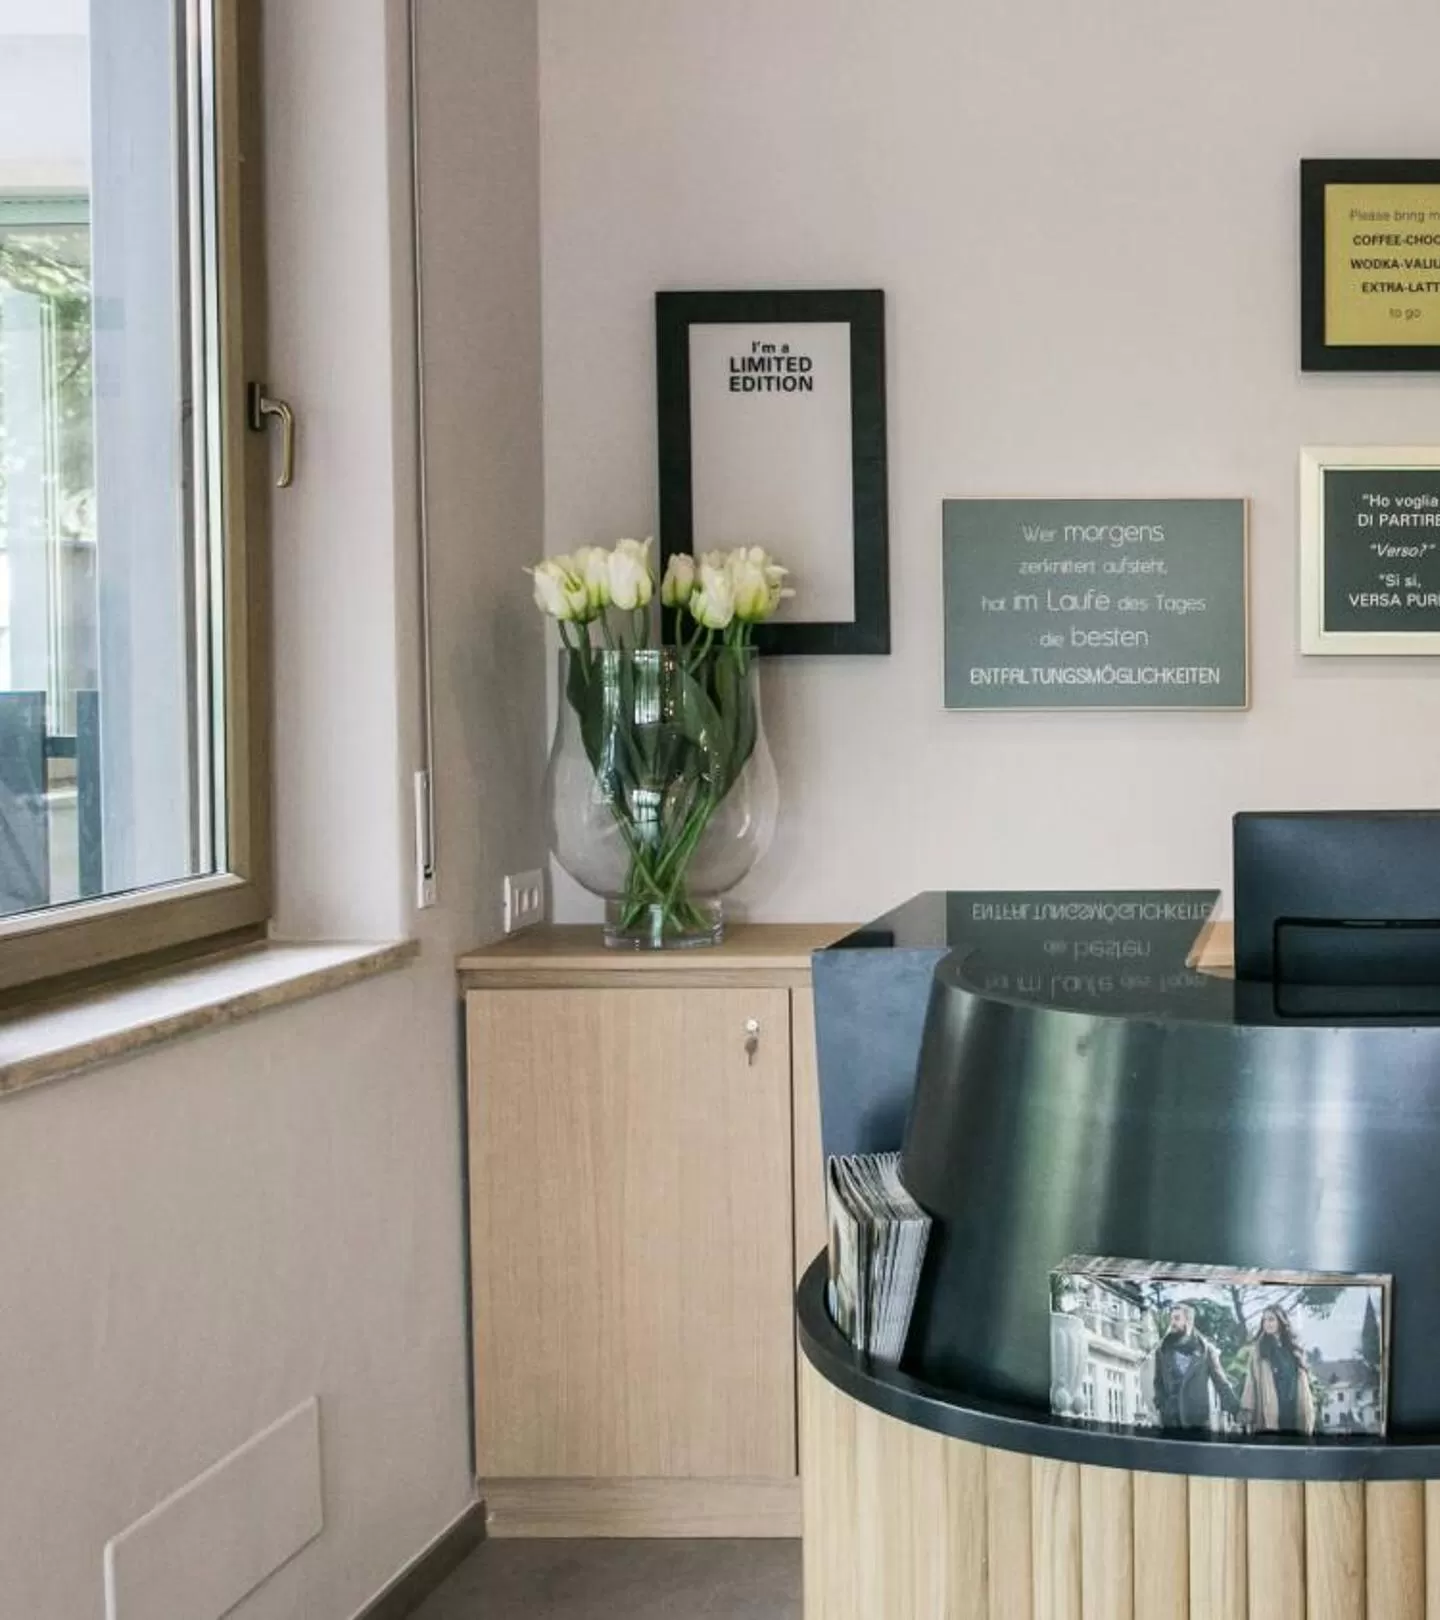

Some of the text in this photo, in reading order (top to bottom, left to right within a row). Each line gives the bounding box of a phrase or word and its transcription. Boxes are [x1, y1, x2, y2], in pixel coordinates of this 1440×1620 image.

[1350, 209, 1390, 221] Please
[1394, 209, 1425, 224] bring
[1389, 308, 1422, 321] to go
[752, 341, 789, 354] I'm a
[729, 356, 813, 373] LIMITED
[729, 376, 813, 392] EDITION
[1395, 493, 1439, 510] voglia
[1358, 514, 1373, 527] DI
[1022, 524, 1165, 548] Wer morgens
[1103, 557, 1168, 575] aufsteht,
[981, 589, 1206, 615] hat im Laufe des Tages
[1349, 593, 1401, 607] VERSA
[1039, 625, 1149, 647] die besten
[970, 664, 1220, 685] ENTFALTUNGSMÖGLICHKEITEN
